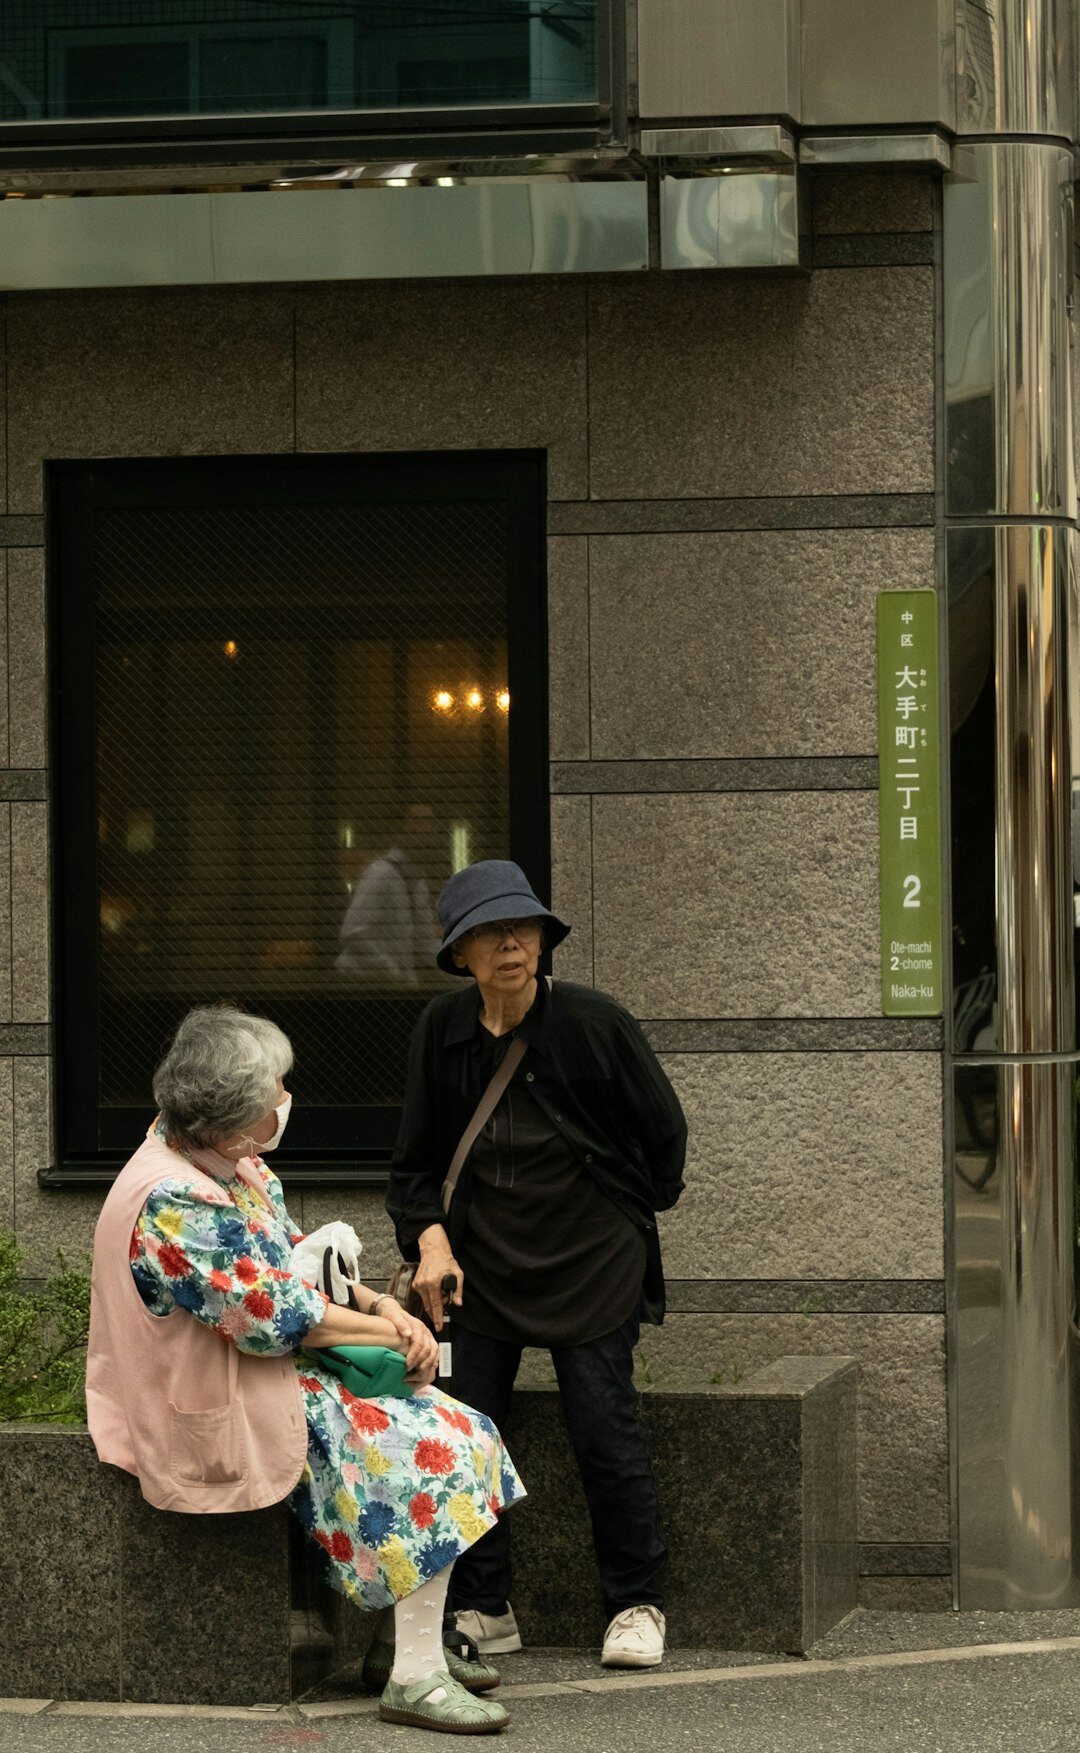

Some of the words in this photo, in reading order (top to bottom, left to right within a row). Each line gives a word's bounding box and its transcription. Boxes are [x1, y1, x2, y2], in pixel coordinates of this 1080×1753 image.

[901, 610, 914, 647] 中区
[895, 665, 920, 840] 大手町二丁目
[902, 874, 922, 908] 2
[890, 941, 932, 954] Ote-machi
[890, 956, 933, 971] 2-chome
[891, 984, 934, 998] Naka-ku
